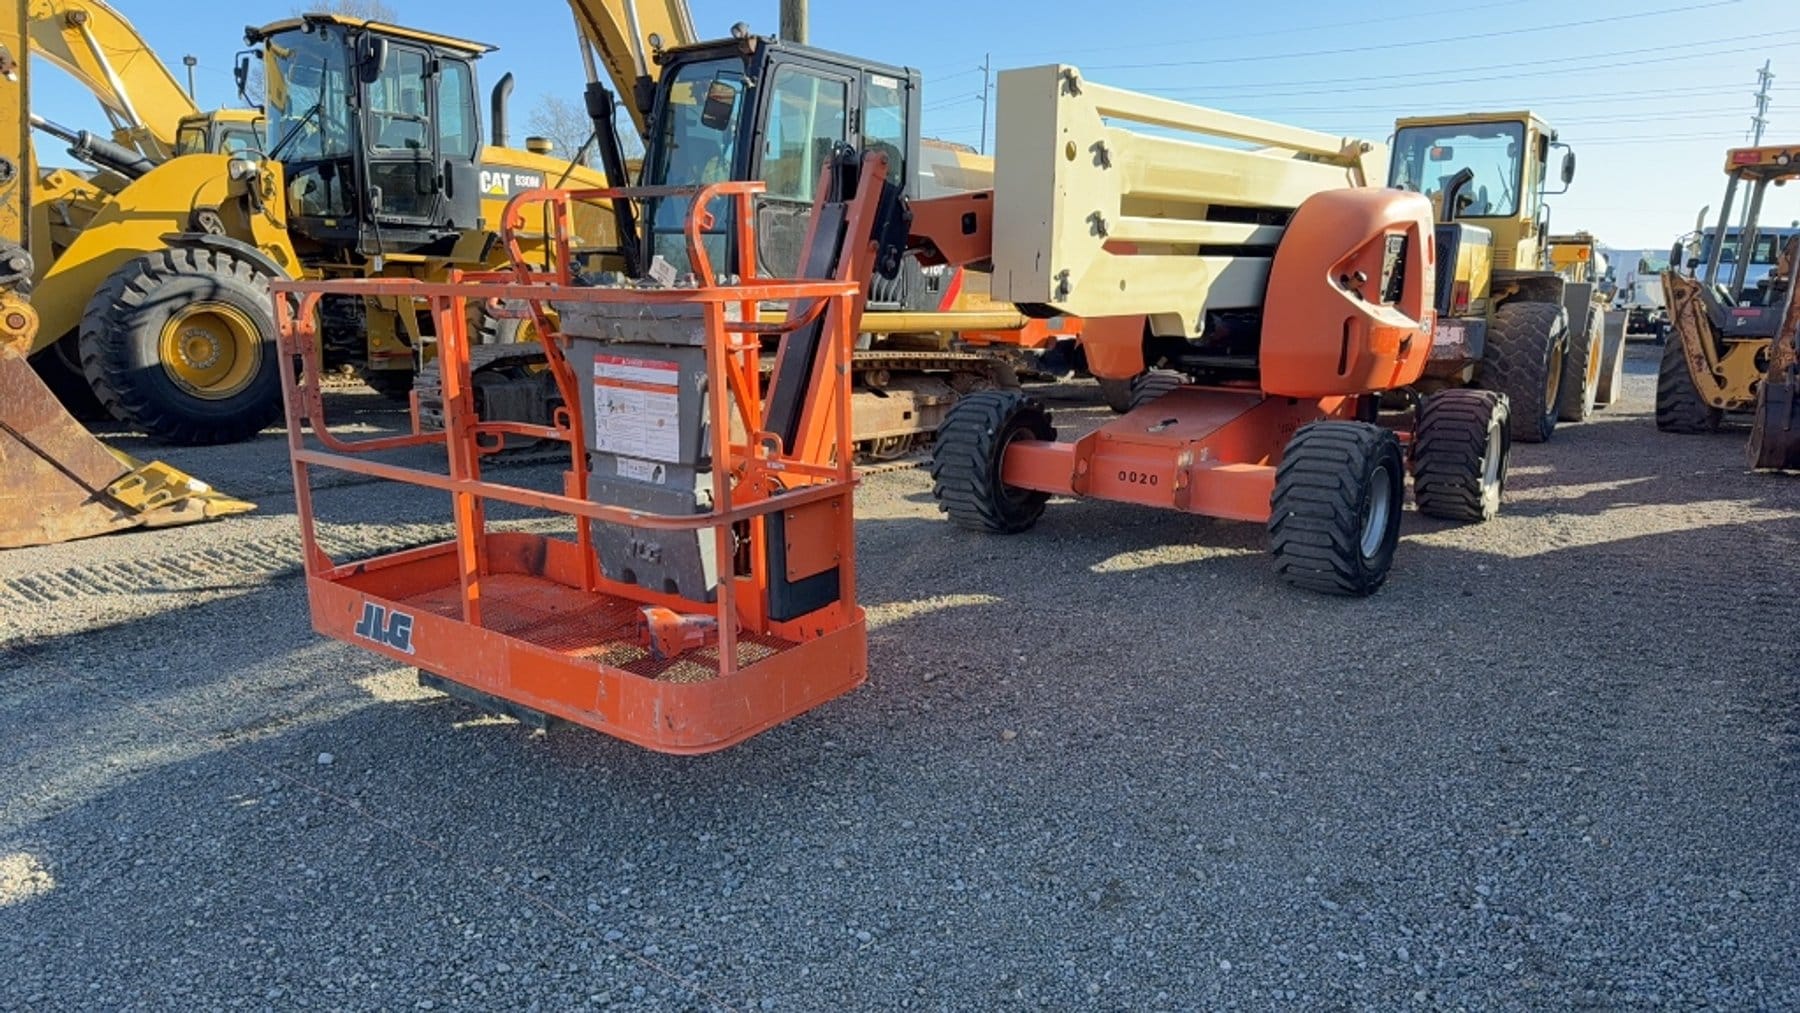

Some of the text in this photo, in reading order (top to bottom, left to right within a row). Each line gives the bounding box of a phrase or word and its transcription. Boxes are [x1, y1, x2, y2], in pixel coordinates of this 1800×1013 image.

[480, 171, 511, 195] CAT
[1118, 470, 1158, 486] 0020
[354, 601, 414, 655] JLG
